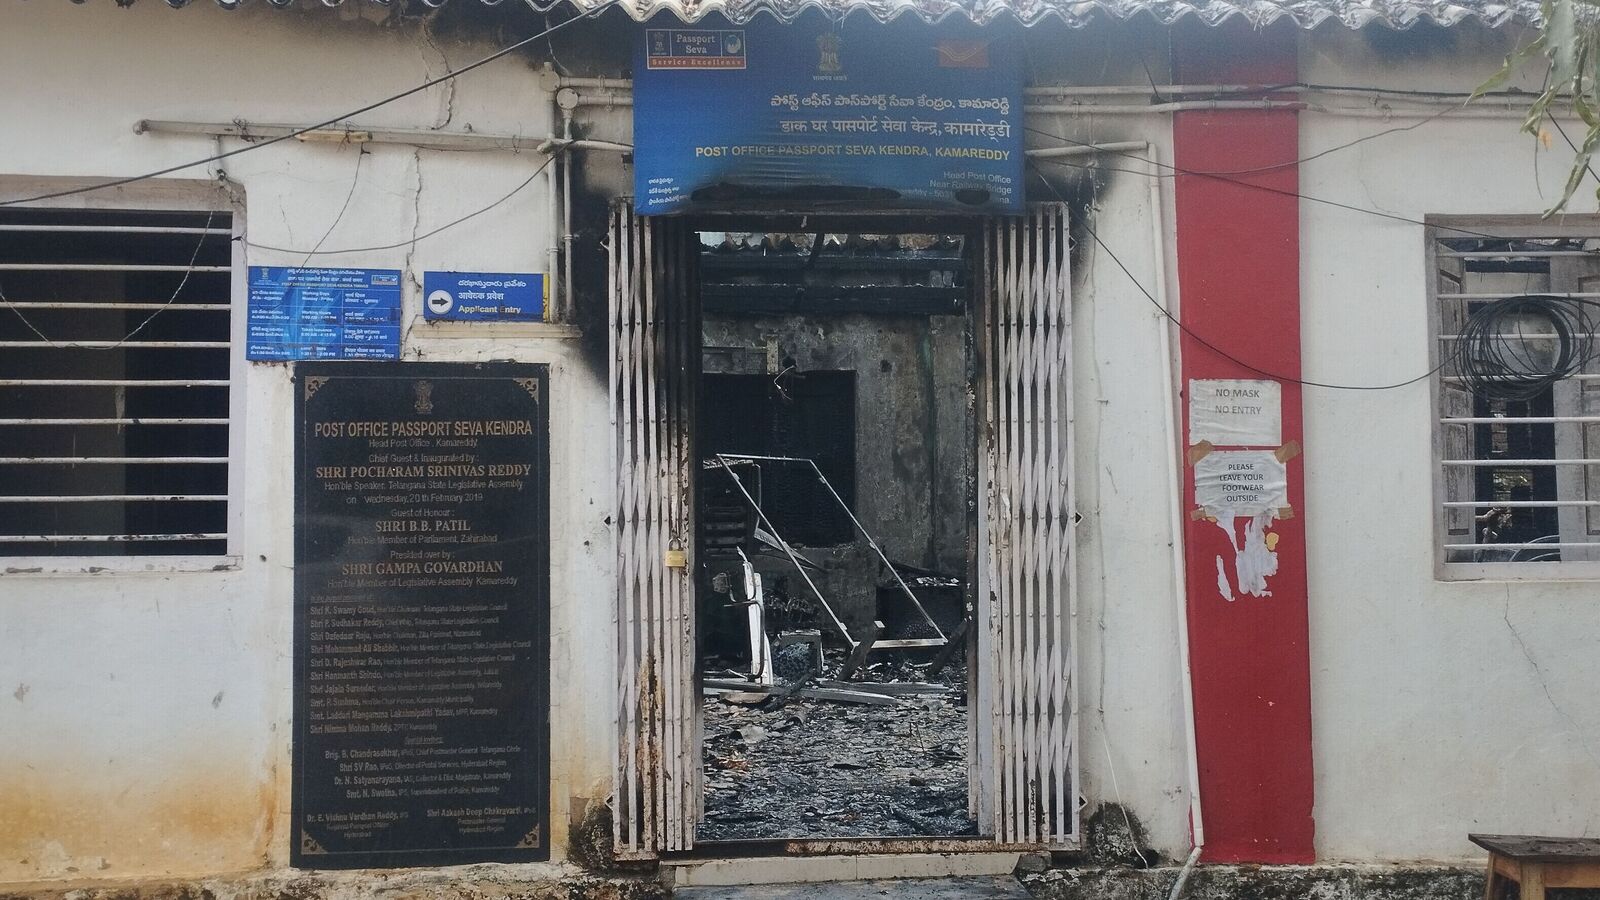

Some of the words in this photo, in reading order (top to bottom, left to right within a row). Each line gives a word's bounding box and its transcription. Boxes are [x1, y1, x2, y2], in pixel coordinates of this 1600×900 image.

[676, 34, 716, 45] Passport
[686, 46, 708, 54] Seva
[779, 120, 808, 133] डाक
[810, 120, 829, 132] घर
[831, 115, 879, 133] पासपोर्ट
[881, 116, 907, 133] सेवा
[695, 146, 729, 157] POST
[731, 145, 776, 157] OFFICE
[778, 145, 842, 156] PASSPORT
[845, 145, 877, 156] SEVA
[879, 145, 932, 157] KENDRA,
[935, 146, 1011, 161] KAMAREDDY
[943, 170, 966, 180] Head
[967, 171, 986, 181] Post
[987, 173, 1012, 184] Office
[929, 179, 950, 189] Near
[985, 183, 1013, 196] Bridge
[458, 290, 485, 300] आवेदक
[486, 290, 504, 300] प्रवेश
[458, 305, 498, 314] Applicant
[500, 305, 522, 314] Entry
[1215, 388, 1230, 397] NO
[1232, 389, 1260, 398] MASK
[1215, 405, 1230, 414] NO
[1232, 406, 1262, 415] ENTRY
[315, 422, 345, 437] POST
[348, 421, 389, 437] OFFICE
[392, 421, 452, 436] PASSPORT
[454, 420, 484, 436] SEVA
[486, 420, 532, 435] KENDRA
[369, 439, 389, 448] Head
[390, 439, 407, 448] Post
[436, 438, 479, 449] Kamareddy
[369, 454, 388, 463] Chief
[390, 453, 412, 463] Guest
[421, 453, 465, 464] Inaugurated
[316, 466, 347, 478] SHRI
[350, 466, 424, 478] POCHARAM
[427, 465, 485, 477] SRINIVAS
[488, 464, 532, 476] REDDY
[1228, 463, 1254, 471] PLEASE
[1243, 473, 1264, 481] YOUR
[388, 480, 426, 491] Telangana
[427, 480, 447, 490] State
[448, 479, 487, 491] Legislative
[1222, 484, 1264, 492] FOOTWEAR
[346, 496, 357, 504] on
[430, 493, 463, 504] February
[464, 492, 484, 502] 2019
[1226, 494, 1259, 502] OUTSIDE
[391, 508, 412, 518] Guest
[413, 508, 423, 518] of
[375, 520, 406, 532] SHRI
[435, 519, 471, 531] PATIL
[377, 535, 408, 545] Member
[410, 535, 418, 544] of
[390, 550, 424, 560] Presided
[424, 551, 441, 559] over
[342, 563, 373, 575] SHRI
[376, 562, 422, 575] GAMPA
[424, 560, 503, 574] GOVARDHAN
[357, 578, 389, 588] Member
[390, 577, 398, 587] of
[398, 577, 438, 588] Legislative
[476, 576, 519, 588] Kamareddy
[310, 607, 324, 616] Shri
[333, 606, 357, 617] Swamy
[310, 620, 324, 629] Shri
[310, 632, 324, 641] Shri
[339, 762, 353, 772] Shri
